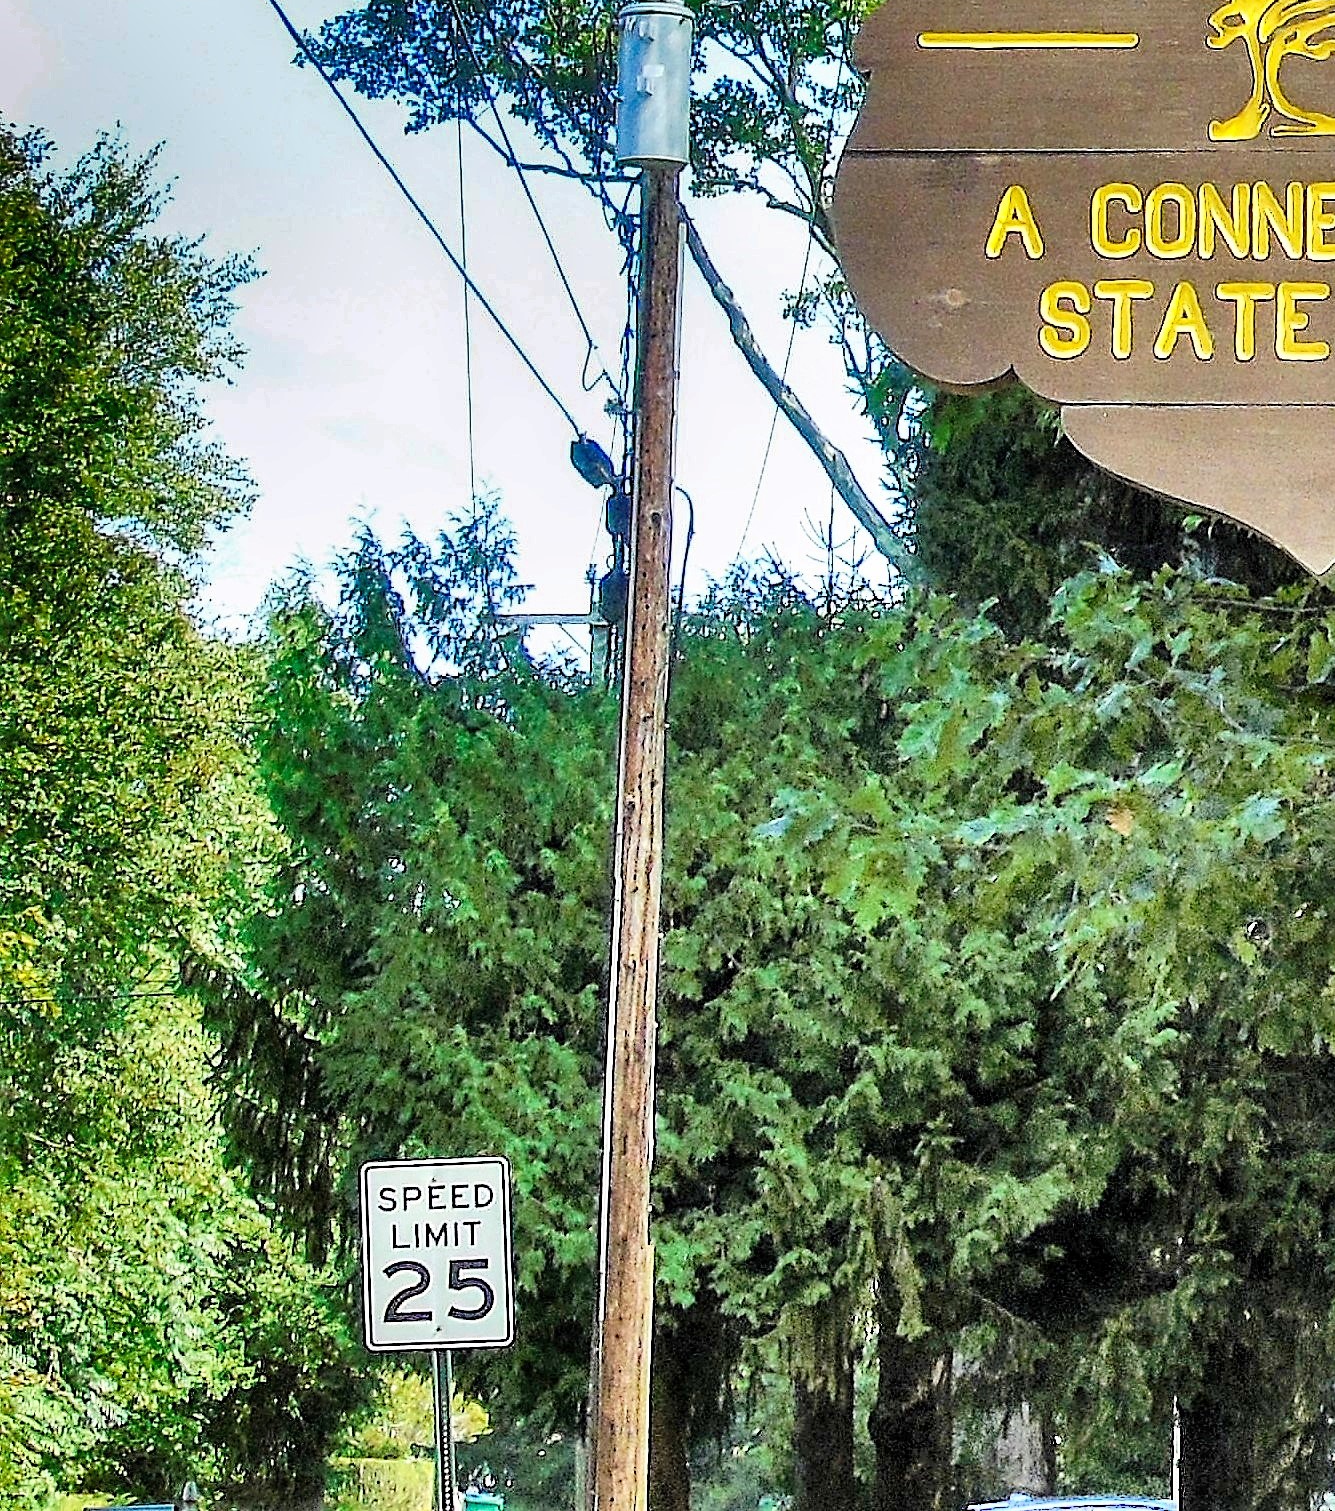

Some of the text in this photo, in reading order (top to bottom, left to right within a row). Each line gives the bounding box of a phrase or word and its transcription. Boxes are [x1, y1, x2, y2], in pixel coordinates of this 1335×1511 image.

[985, 185, 1045, 259] A
[1039, 280, 1331, 361] STATE
[378, 1184, 494, 1212] SPEED
[392, 1221, 481, 1249] LIMIT
[383, 1259, 495, 1323] 25
